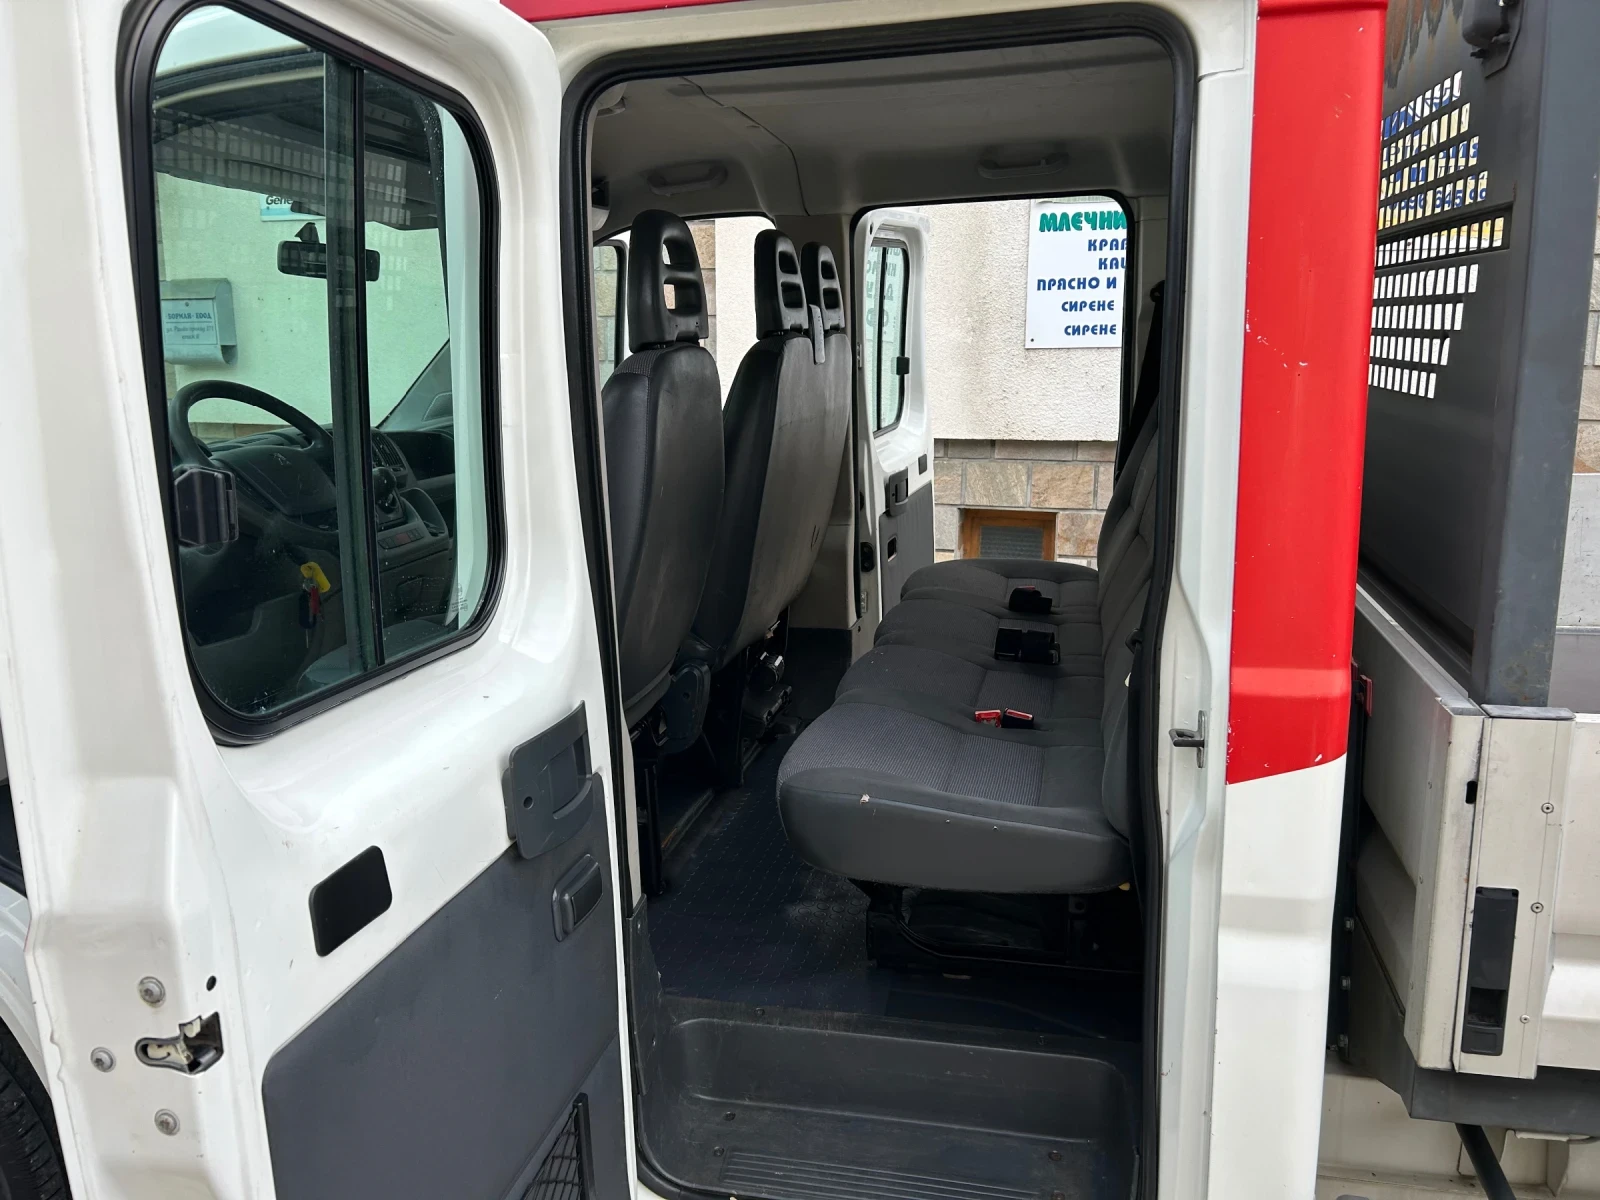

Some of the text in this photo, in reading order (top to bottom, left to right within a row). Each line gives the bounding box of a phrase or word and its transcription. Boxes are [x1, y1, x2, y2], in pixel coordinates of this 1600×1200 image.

[1039, 210, 1128, 232] МЛЕЧНИ
[1036, 276, 1117, 291] ПРЯСНО И
[1061, 300, 1115, 312] СИРЕНЕ
[1064, 324, 1117, 336] СИРЕНЕ
